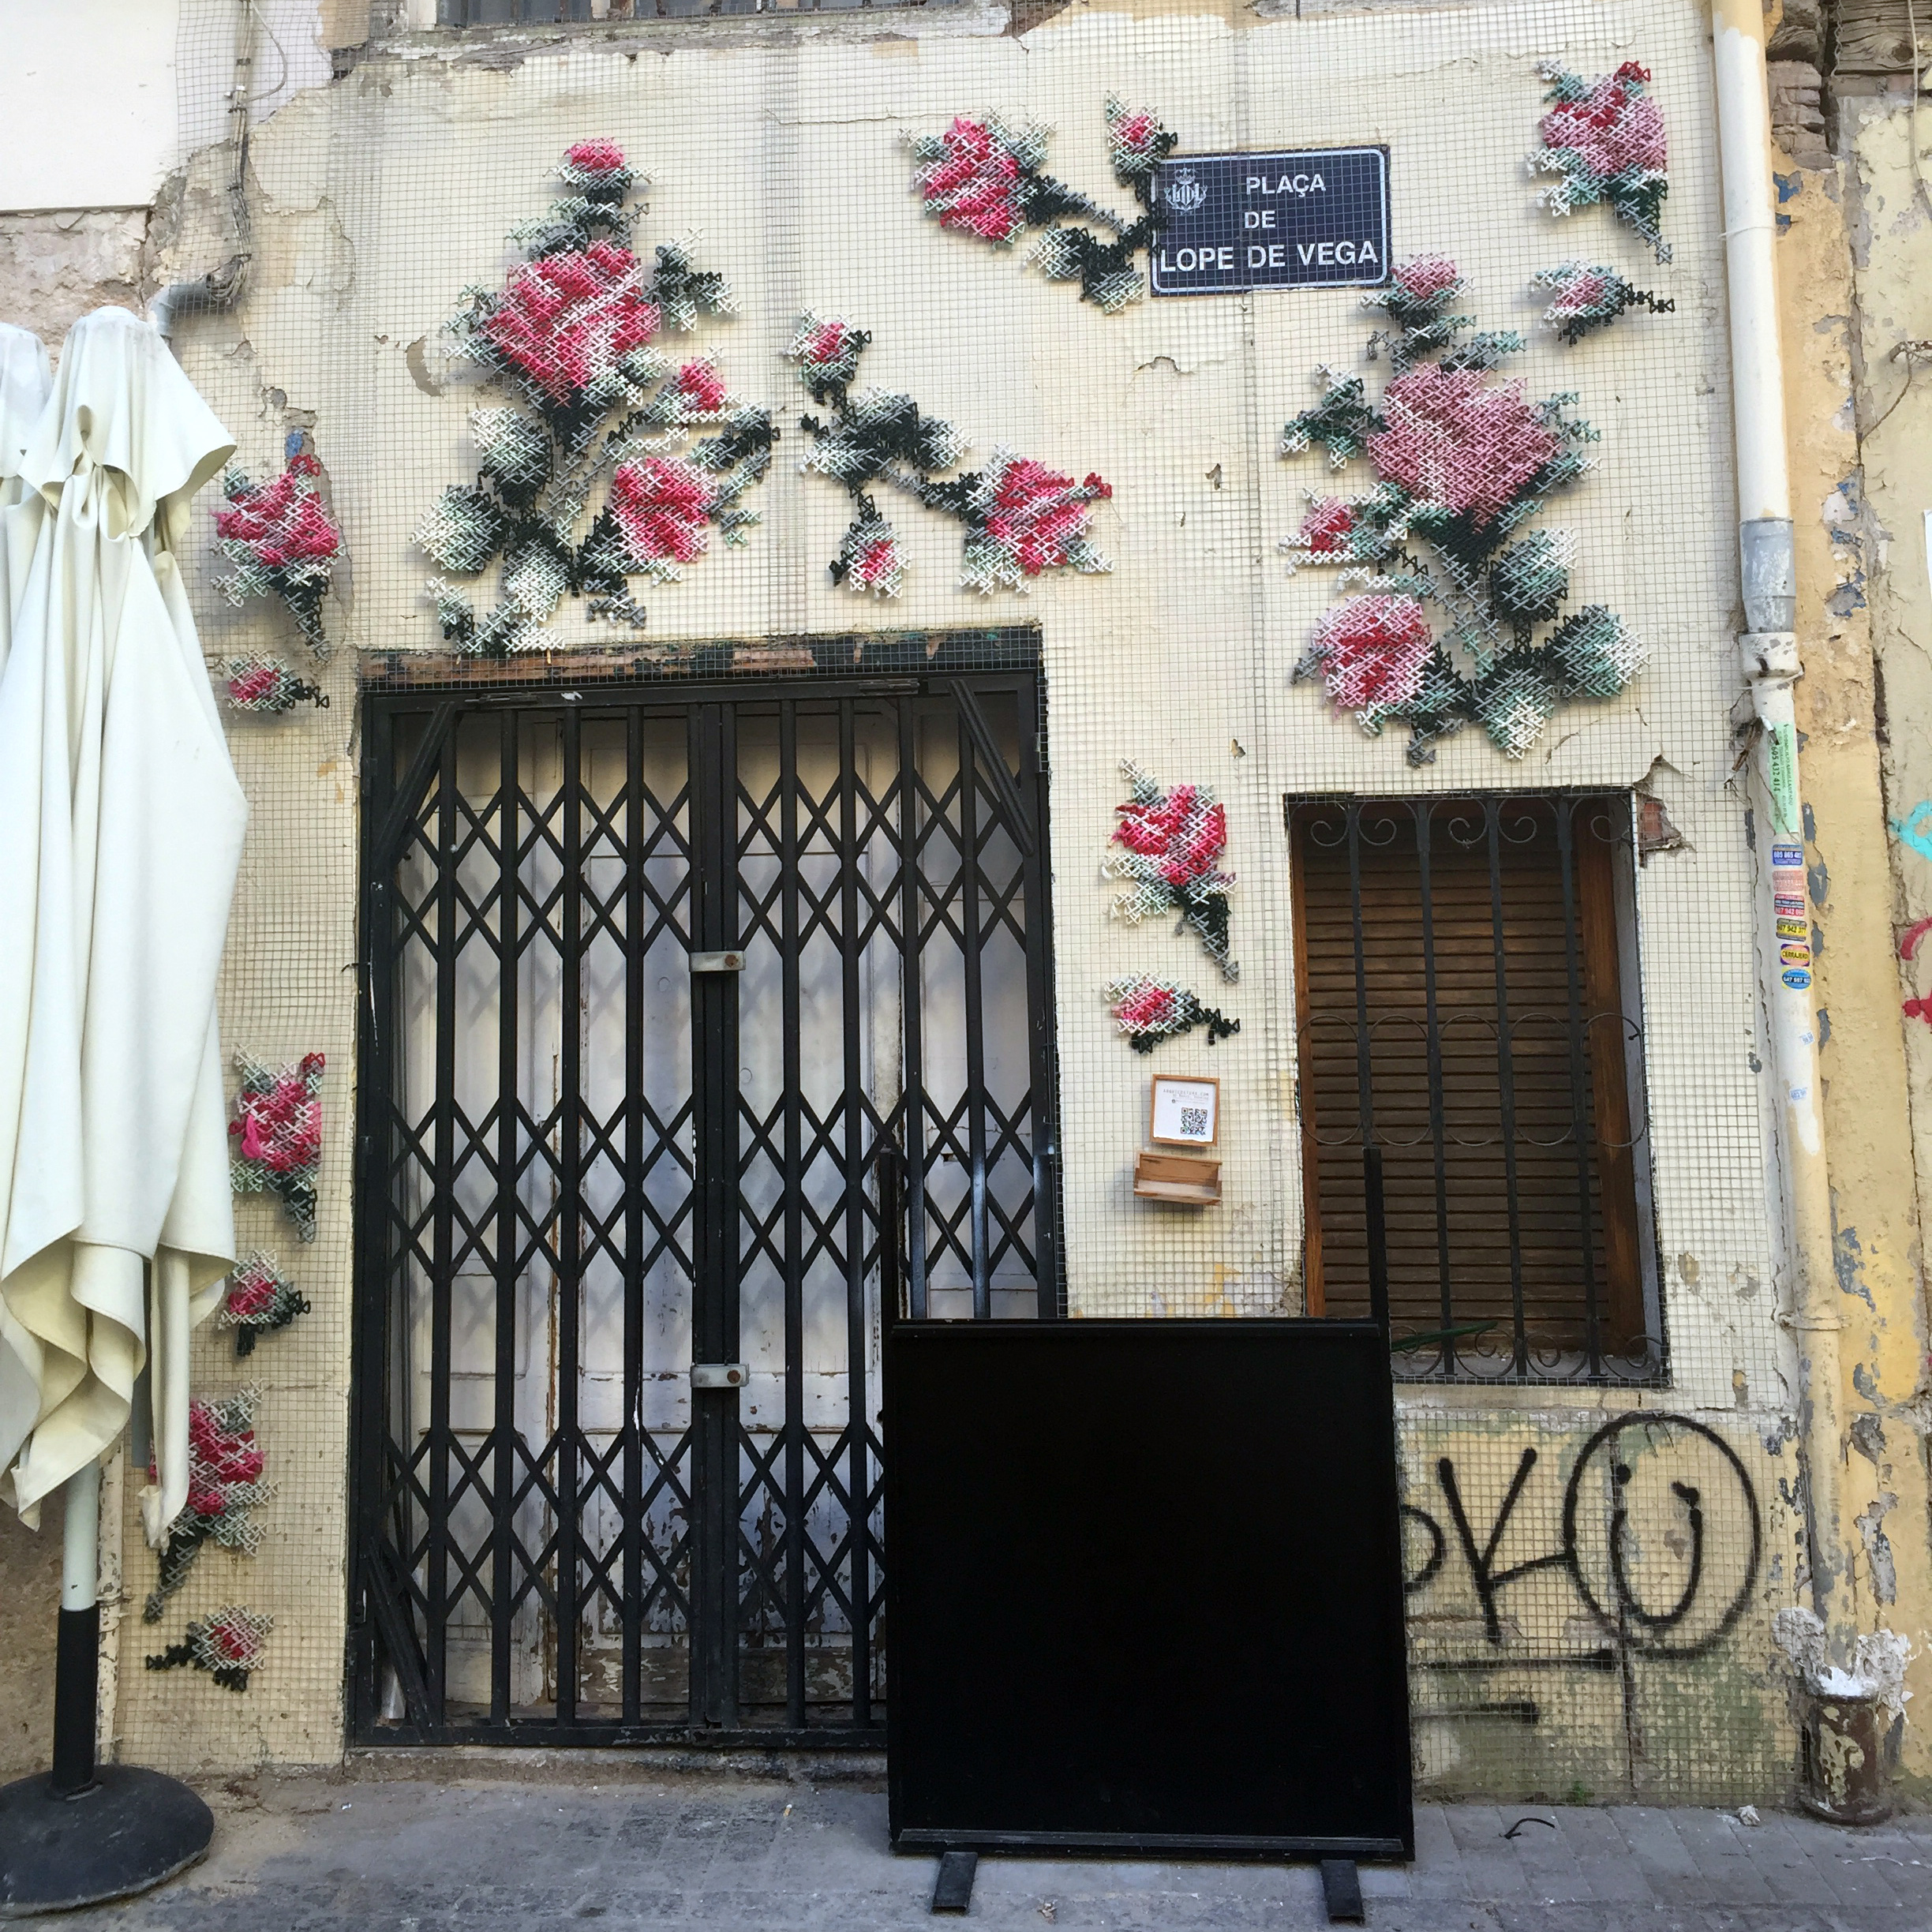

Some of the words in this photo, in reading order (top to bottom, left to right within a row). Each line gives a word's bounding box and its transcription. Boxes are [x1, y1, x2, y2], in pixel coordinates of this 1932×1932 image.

[1246, 174, 1327, 197] PLAÇA
[1245, 210, 1275, 229] DE
[1161, 245, 1235, 273] LOPE
[1247, 244, 1286, 268] DE
[1297, 240, 1379, 267] VEGA
[1772, 762, 1780, 776] 432
